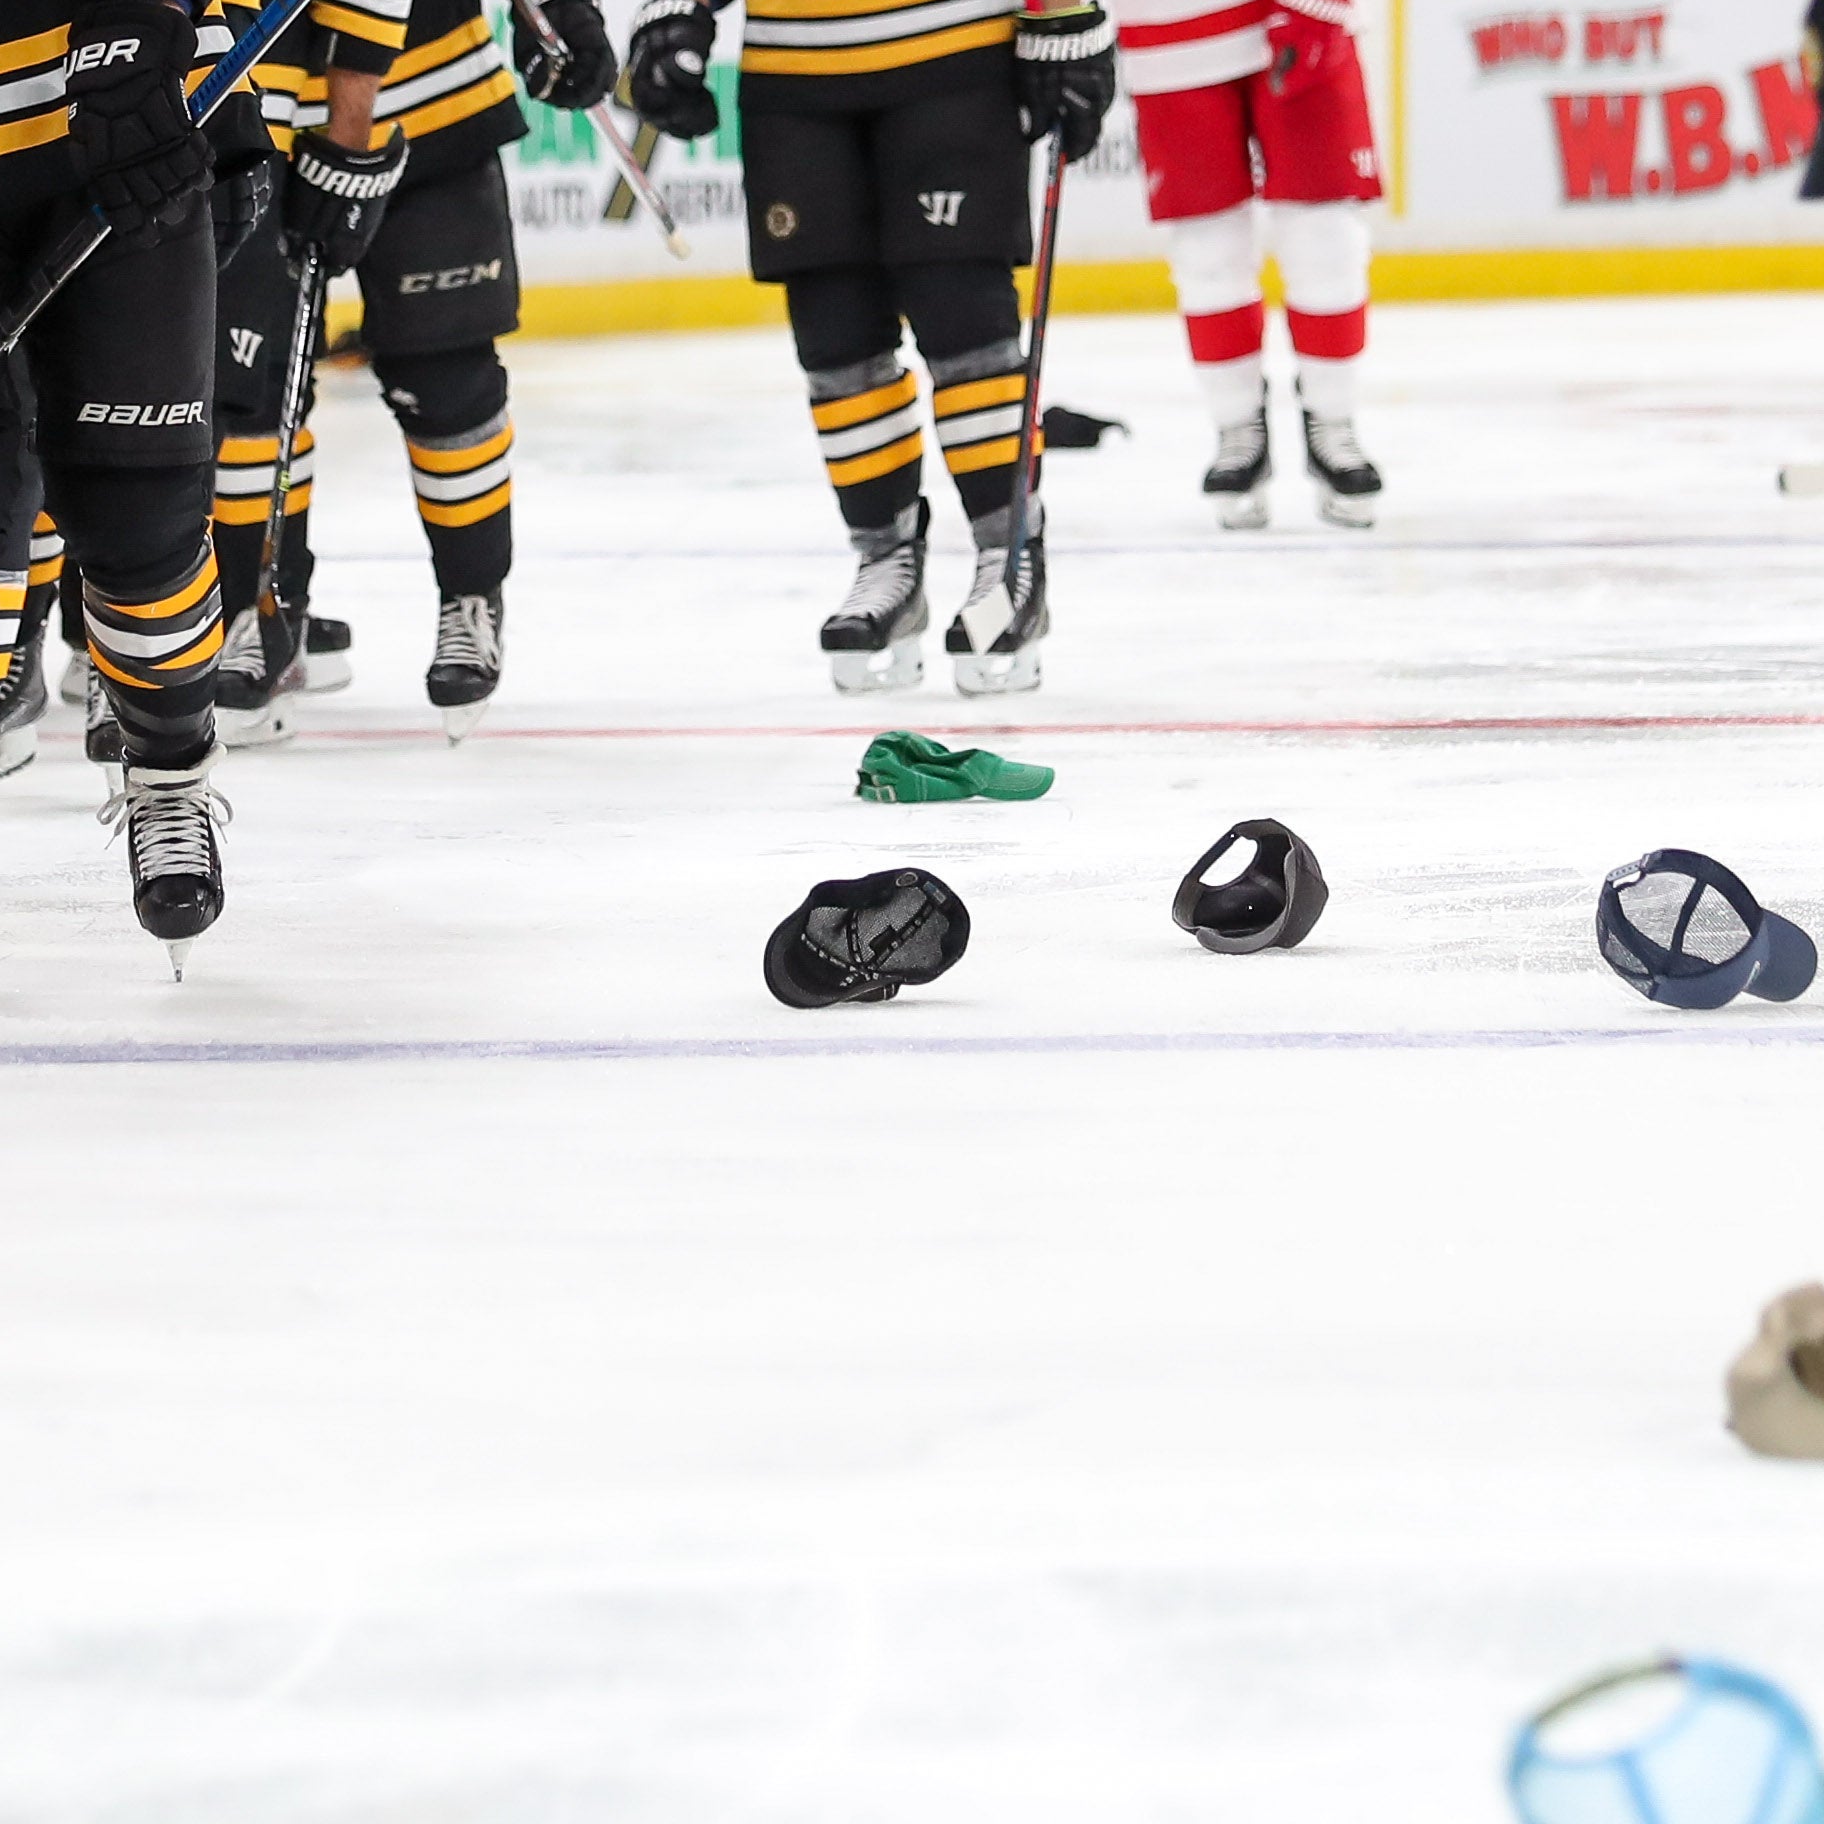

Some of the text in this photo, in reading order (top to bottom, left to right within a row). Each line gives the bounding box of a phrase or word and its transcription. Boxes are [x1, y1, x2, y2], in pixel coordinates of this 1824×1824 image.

[1471, 13, 1664, 67] WHO BUT
[398, 258, 503, 295] CCM
[77, 401, 207, 426] BAUER
